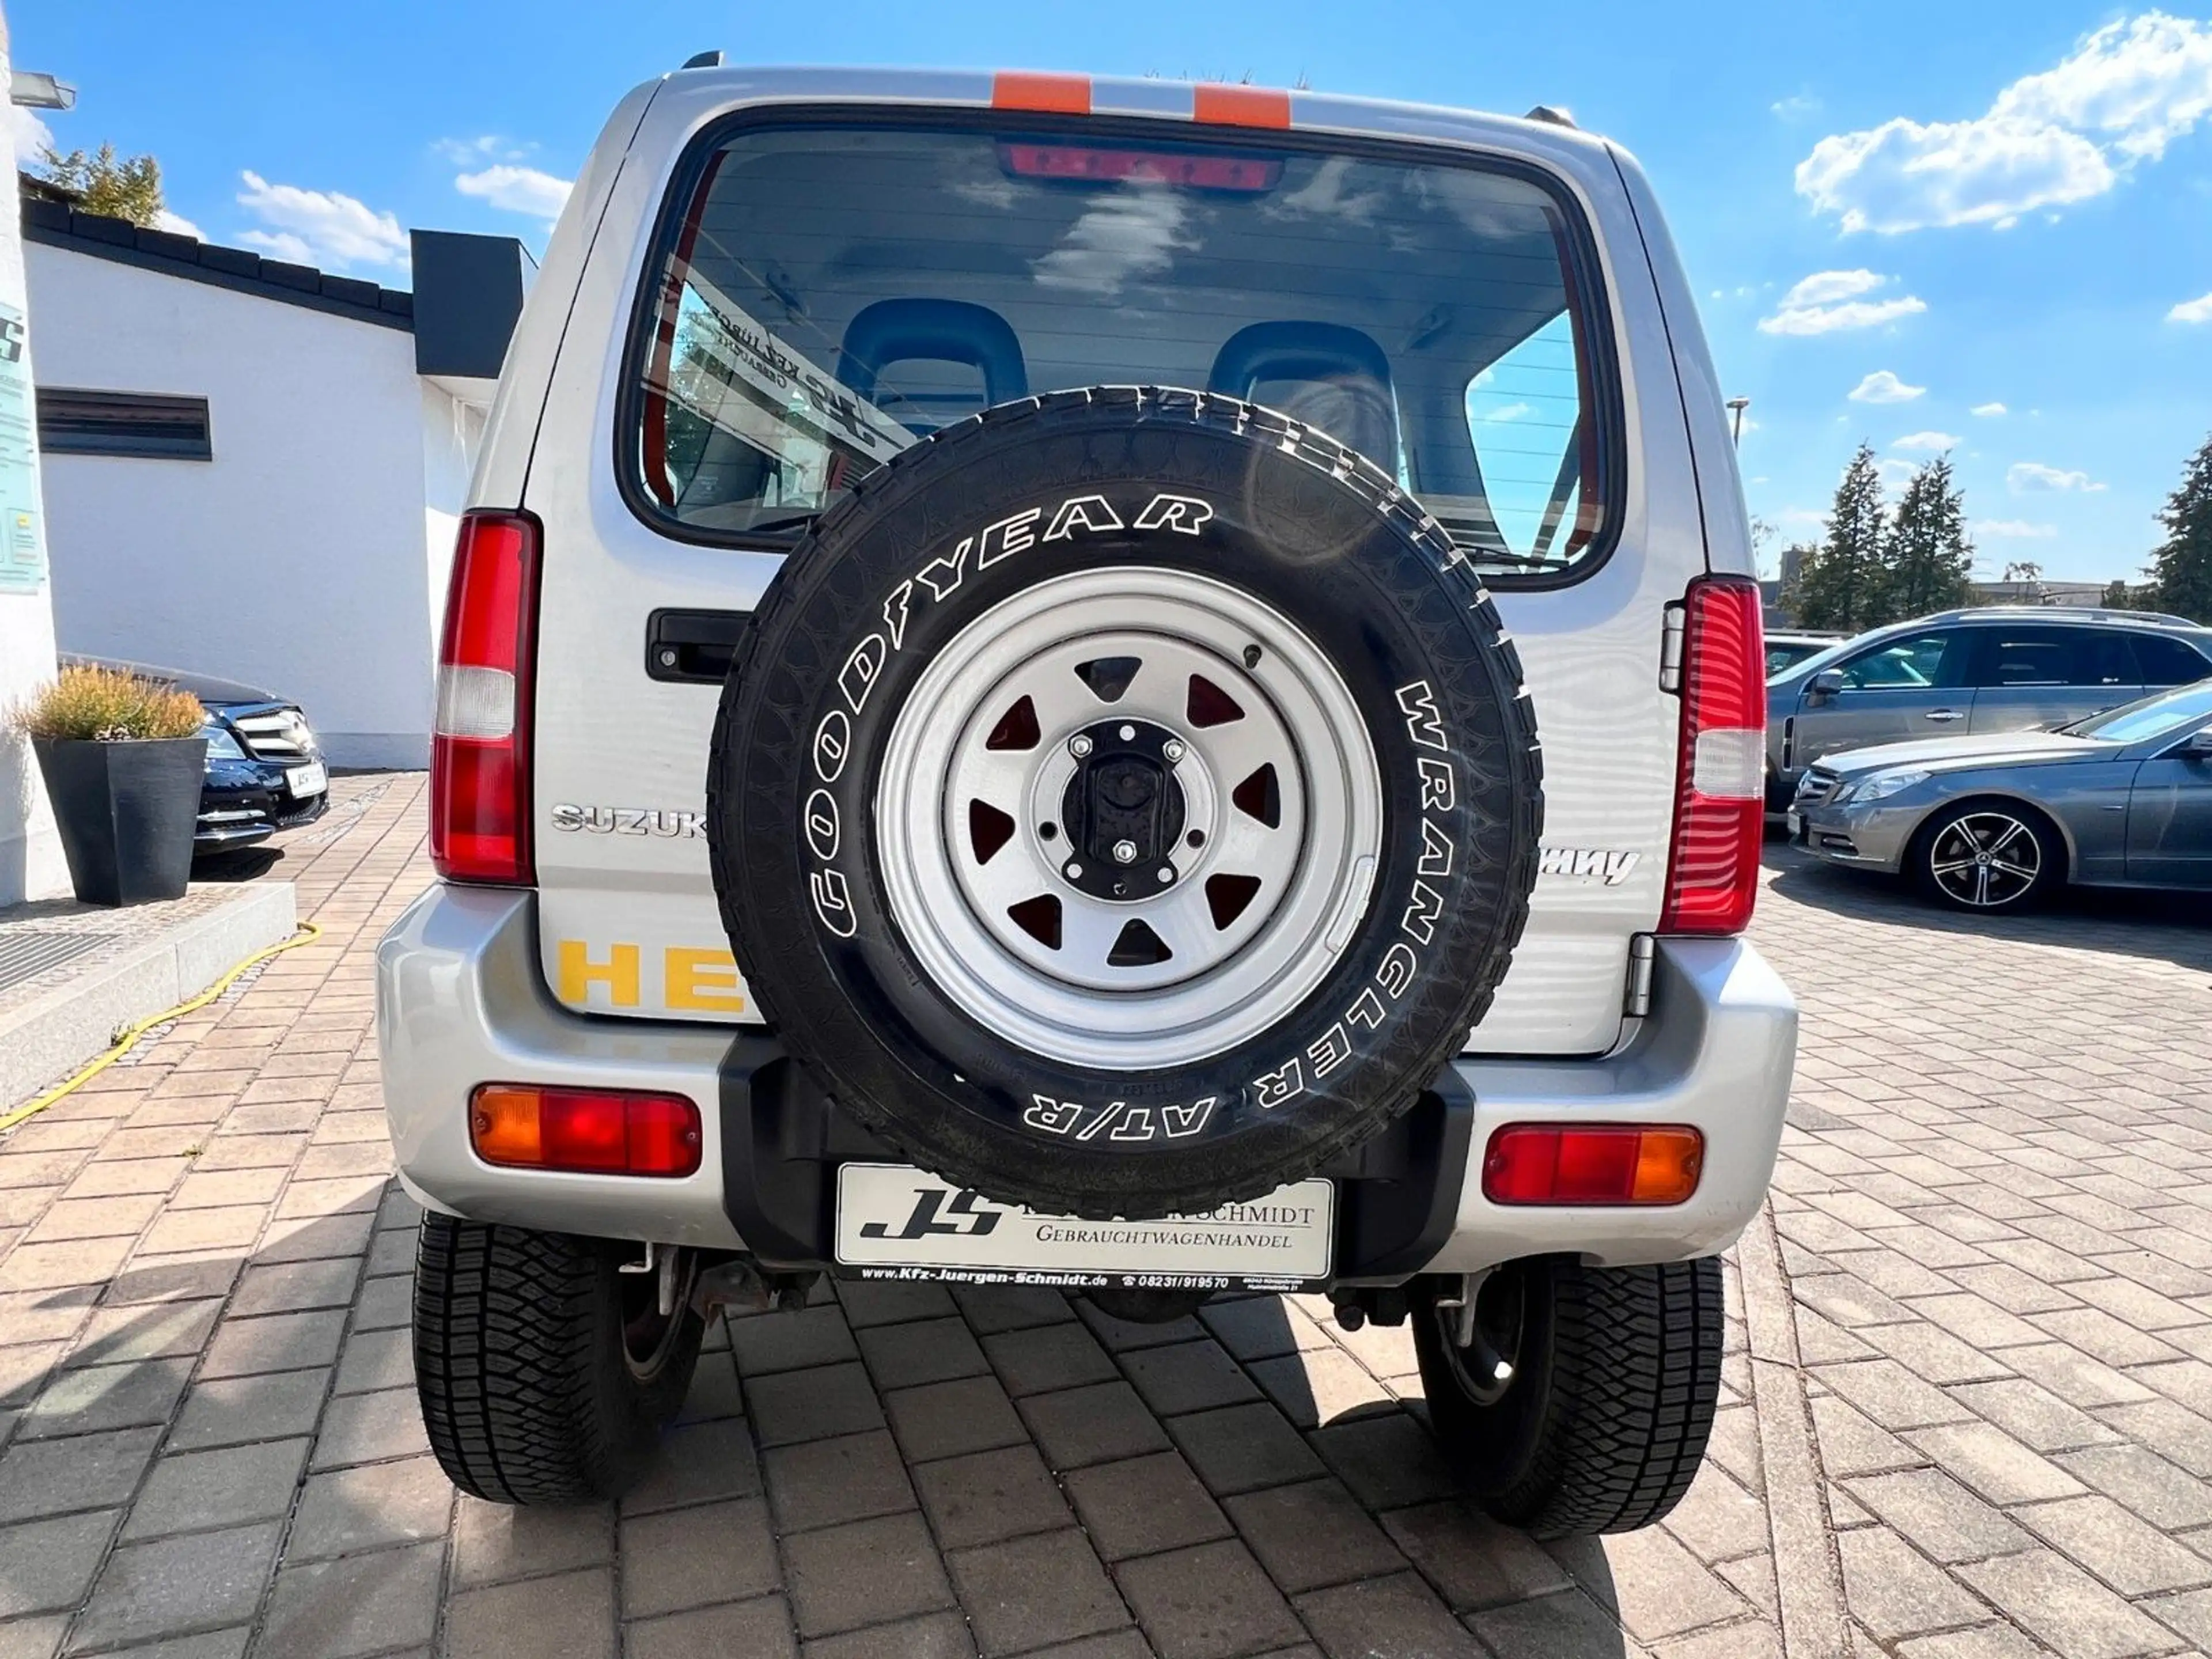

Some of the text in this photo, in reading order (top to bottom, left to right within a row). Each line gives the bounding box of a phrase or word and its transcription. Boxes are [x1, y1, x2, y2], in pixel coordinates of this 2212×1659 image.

[804, 493, 1216, 938] GOODYEAR
[551, 803, 707, 839] SUZUK
[1538, 848, 1641, 887] mny
[1023, 679, 1456, 1141] WRANGLER AT/R
[558, 939, 744, 1013] HE
[859, 1188, 1002, 1240] JS
[1035, 1224, 1293, 1249] GEBRAUCHTWAGENHANDEL
[861, 1267, 1108, 1286] www.Kfz-Juergen-Schmidt.de
[1138, 1275, 1229, 1289] 08231/919570
